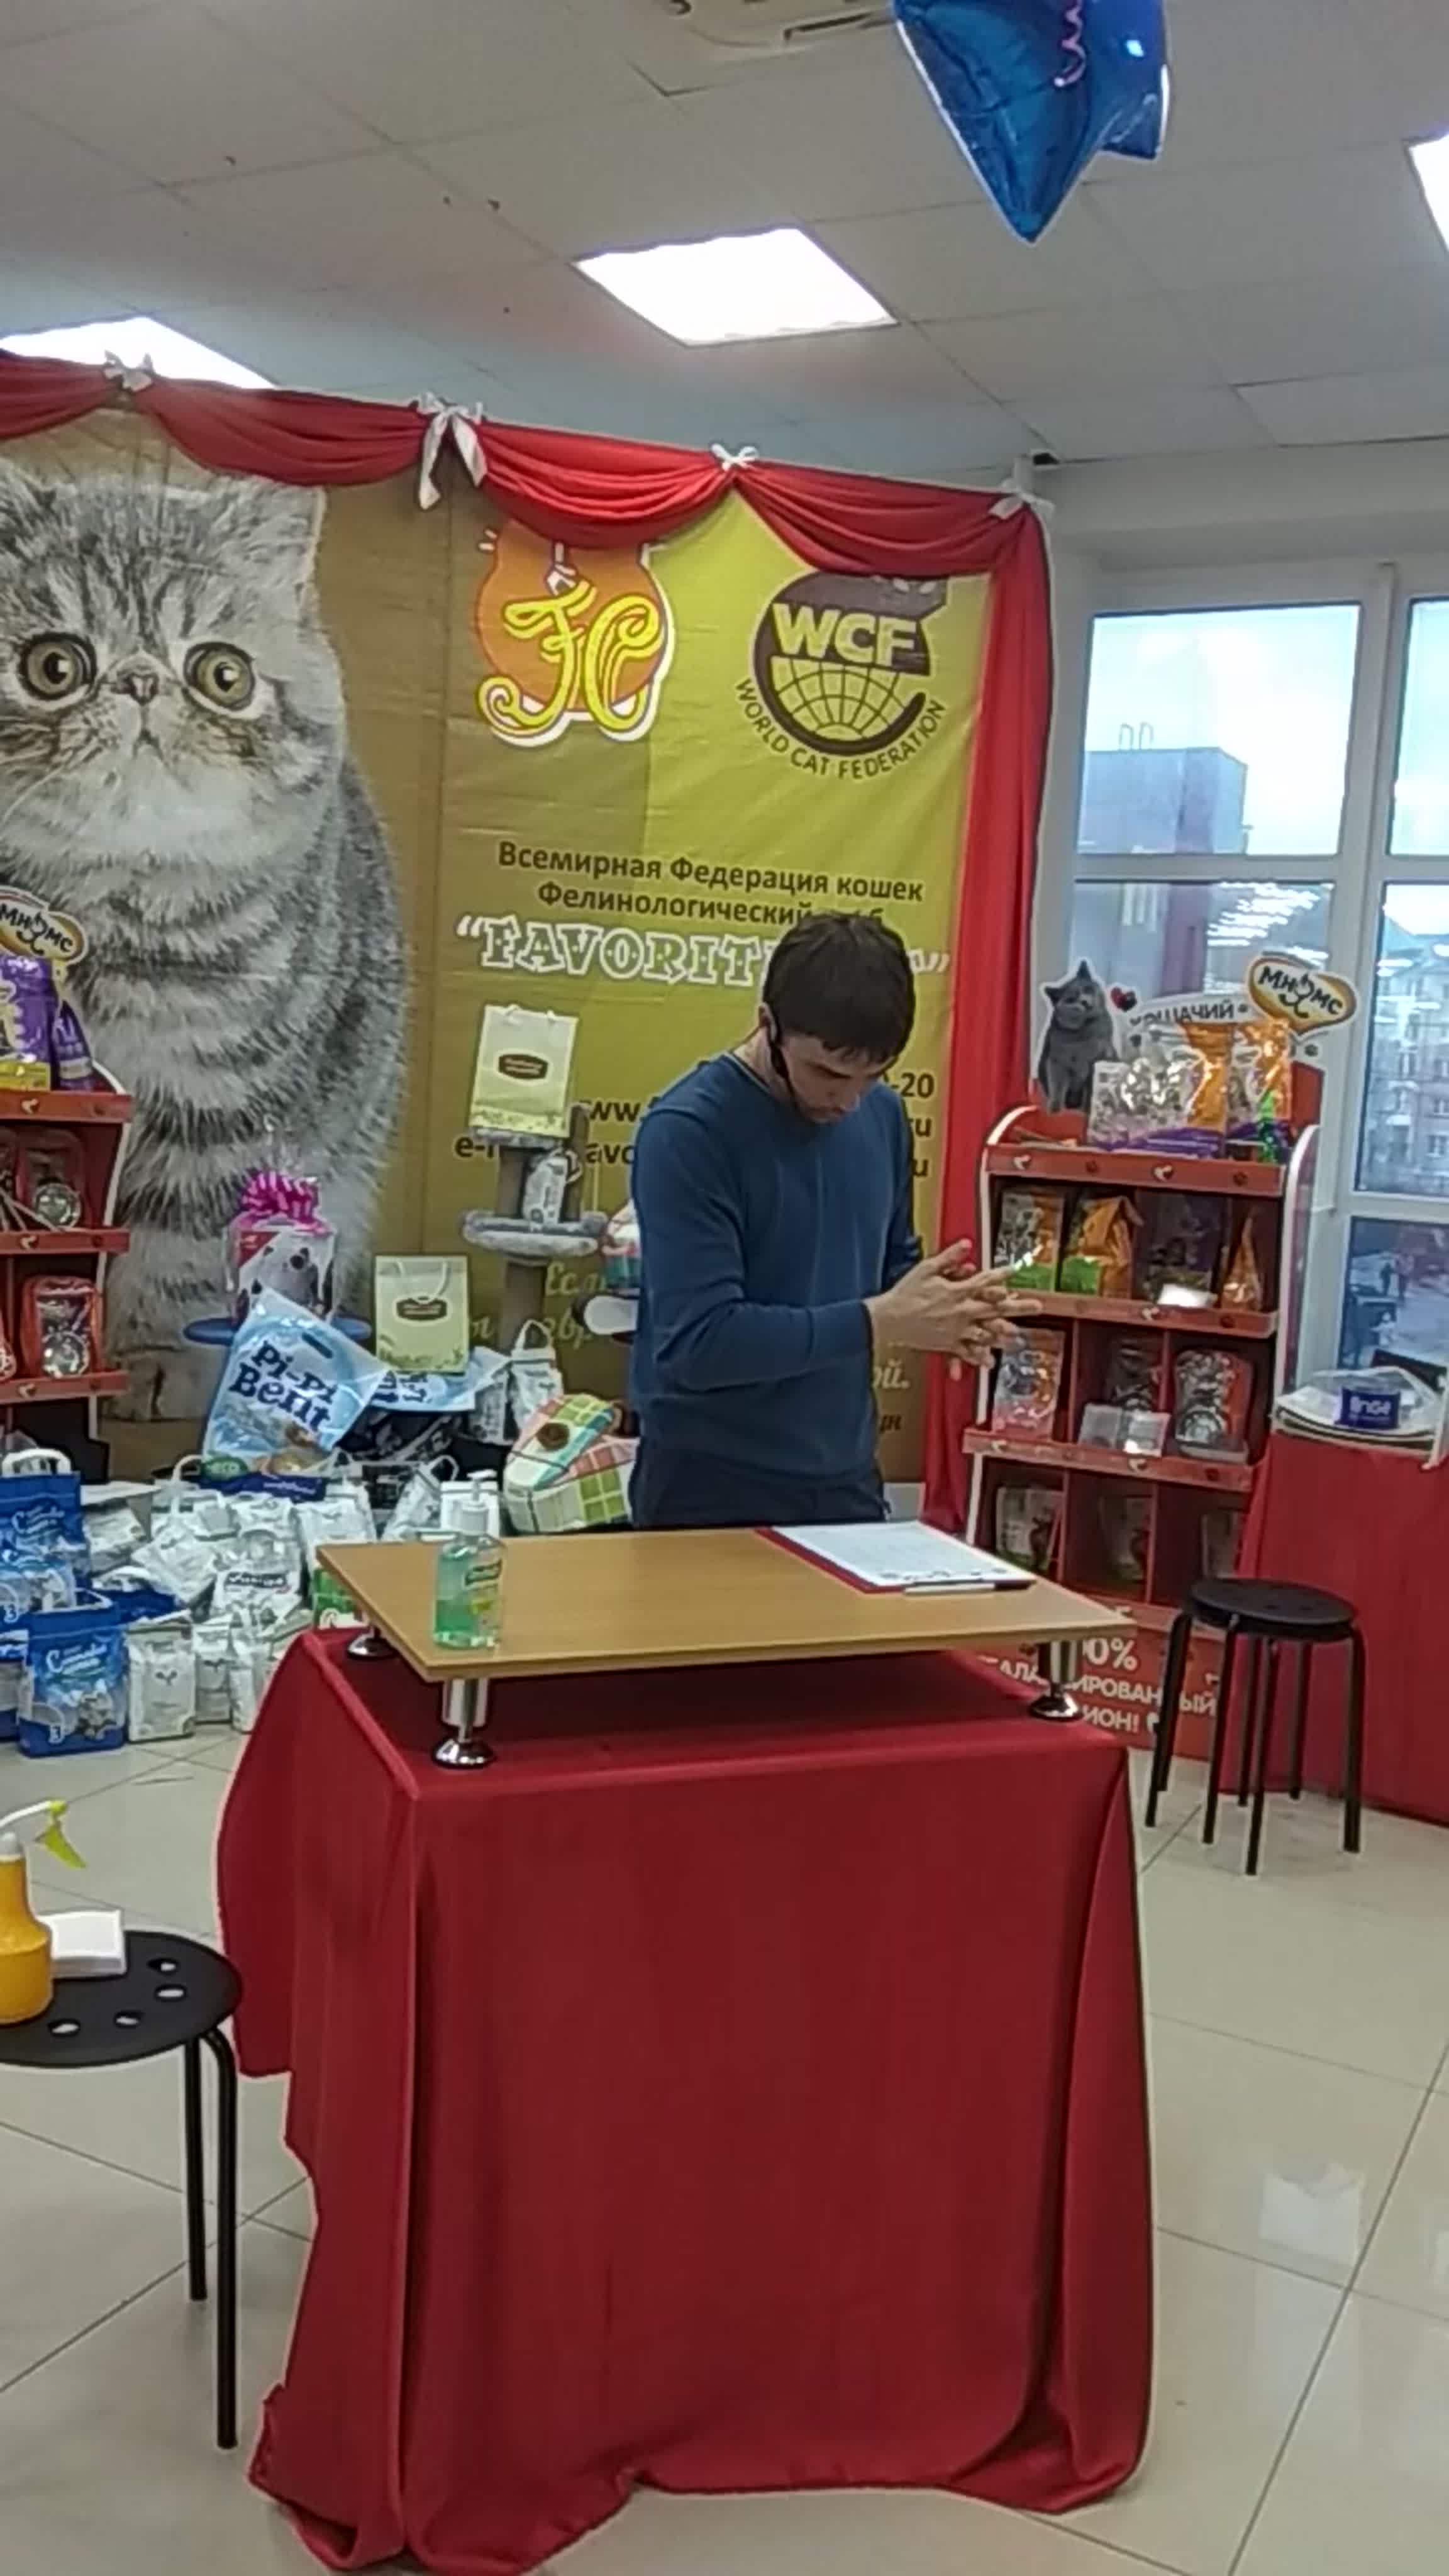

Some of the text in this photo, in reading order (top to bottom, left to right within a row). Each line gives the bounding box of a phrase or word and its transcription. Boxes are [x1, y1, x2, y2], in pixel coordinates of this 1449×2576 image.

[771, 602, 918, 668] WCF
[735, 678, 946, 780] WORLD CAT FEDERATION
[498, 841, 924, 901] Всемирная Федерация кошек
[228, 1362, 331, 1432] Bent
[251, 1340, 338, 1404] Pi-Pi
